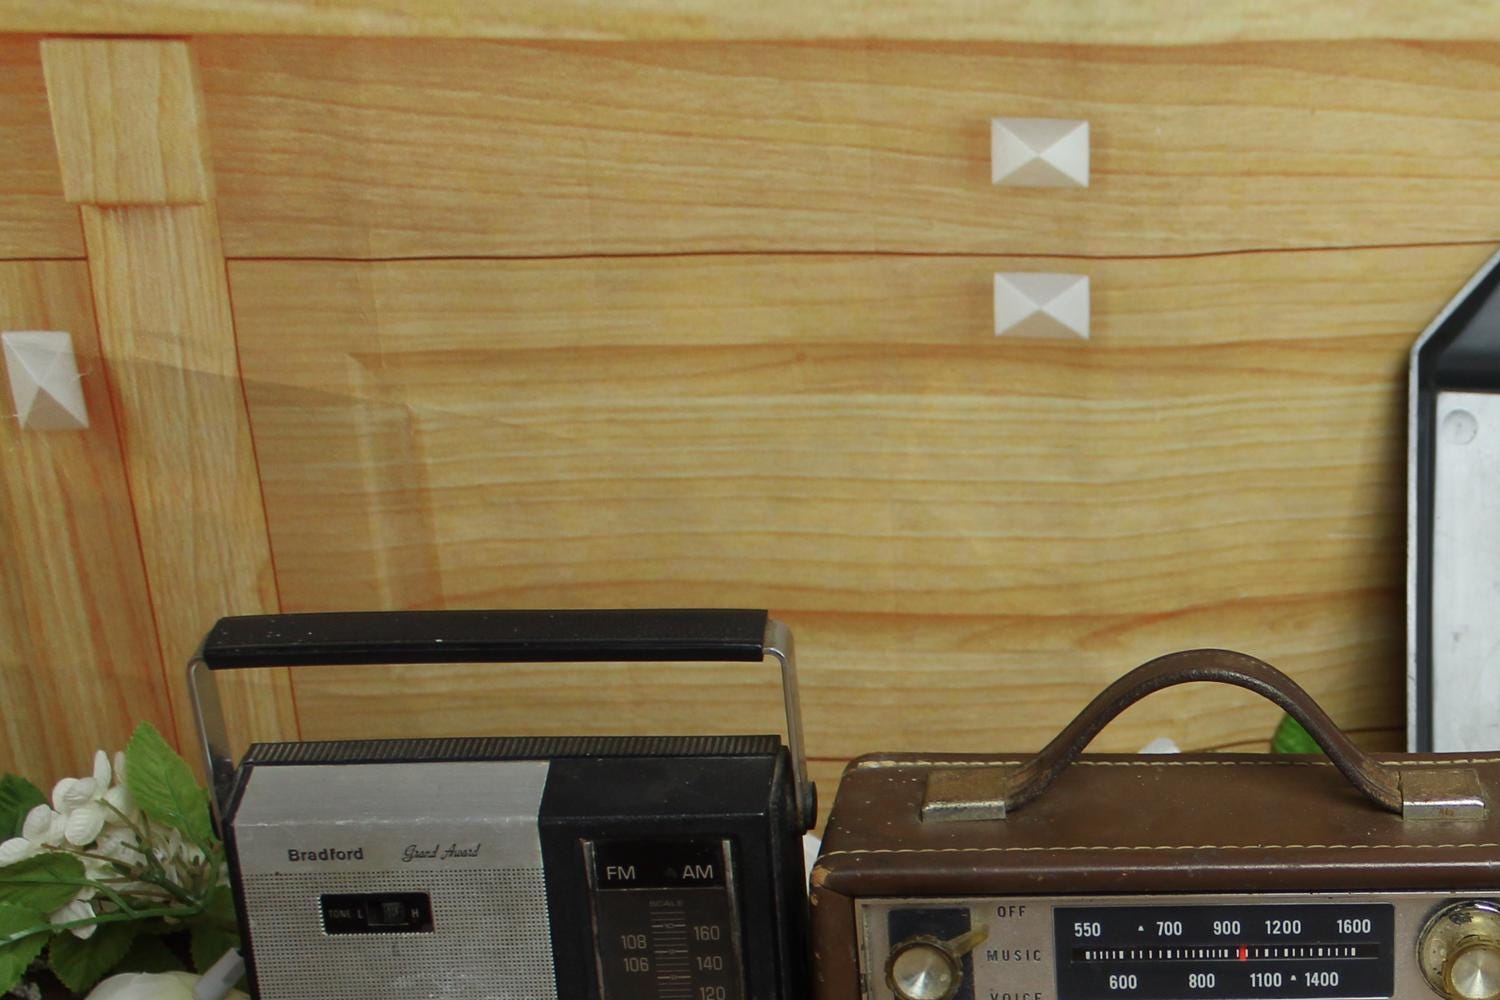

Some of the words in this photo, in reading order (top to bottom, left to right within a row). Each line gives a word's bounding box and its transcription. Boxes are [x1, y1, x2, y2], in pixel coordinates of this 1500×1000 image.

[288, 848, 364, 862] Bradford
[401, 844, 439, 863] Grand
[440, 844, 481, 860] Award
[606, 866, 636, 880] FM
[682, 865, 714, 879] AM
[356, 908, 364, 920] L
[997, 905, 1027, 918] OFF
[693, 925, 720, 941] 160
[1074, 922, 1101, 937] 550
[1156, 921, 1182, 936] 700
[1213, 920, 1241, 936] 900
[1265, 919, 1301, 935] 1200
[1336, 918, 1371, 934] 1600
[620, 934, 647, 950] 108
[697, 955, 723, 971] 140
[986, 949, 1042, 963] MUSIC
[623, 957, 649, 973] 106
[1109, 974, 1138, 990] 600
[1188, 973, 1215, 989] 800
[1250, 972, 1282, 988] 1100
[1305, 971, 1339, 987] 1400
